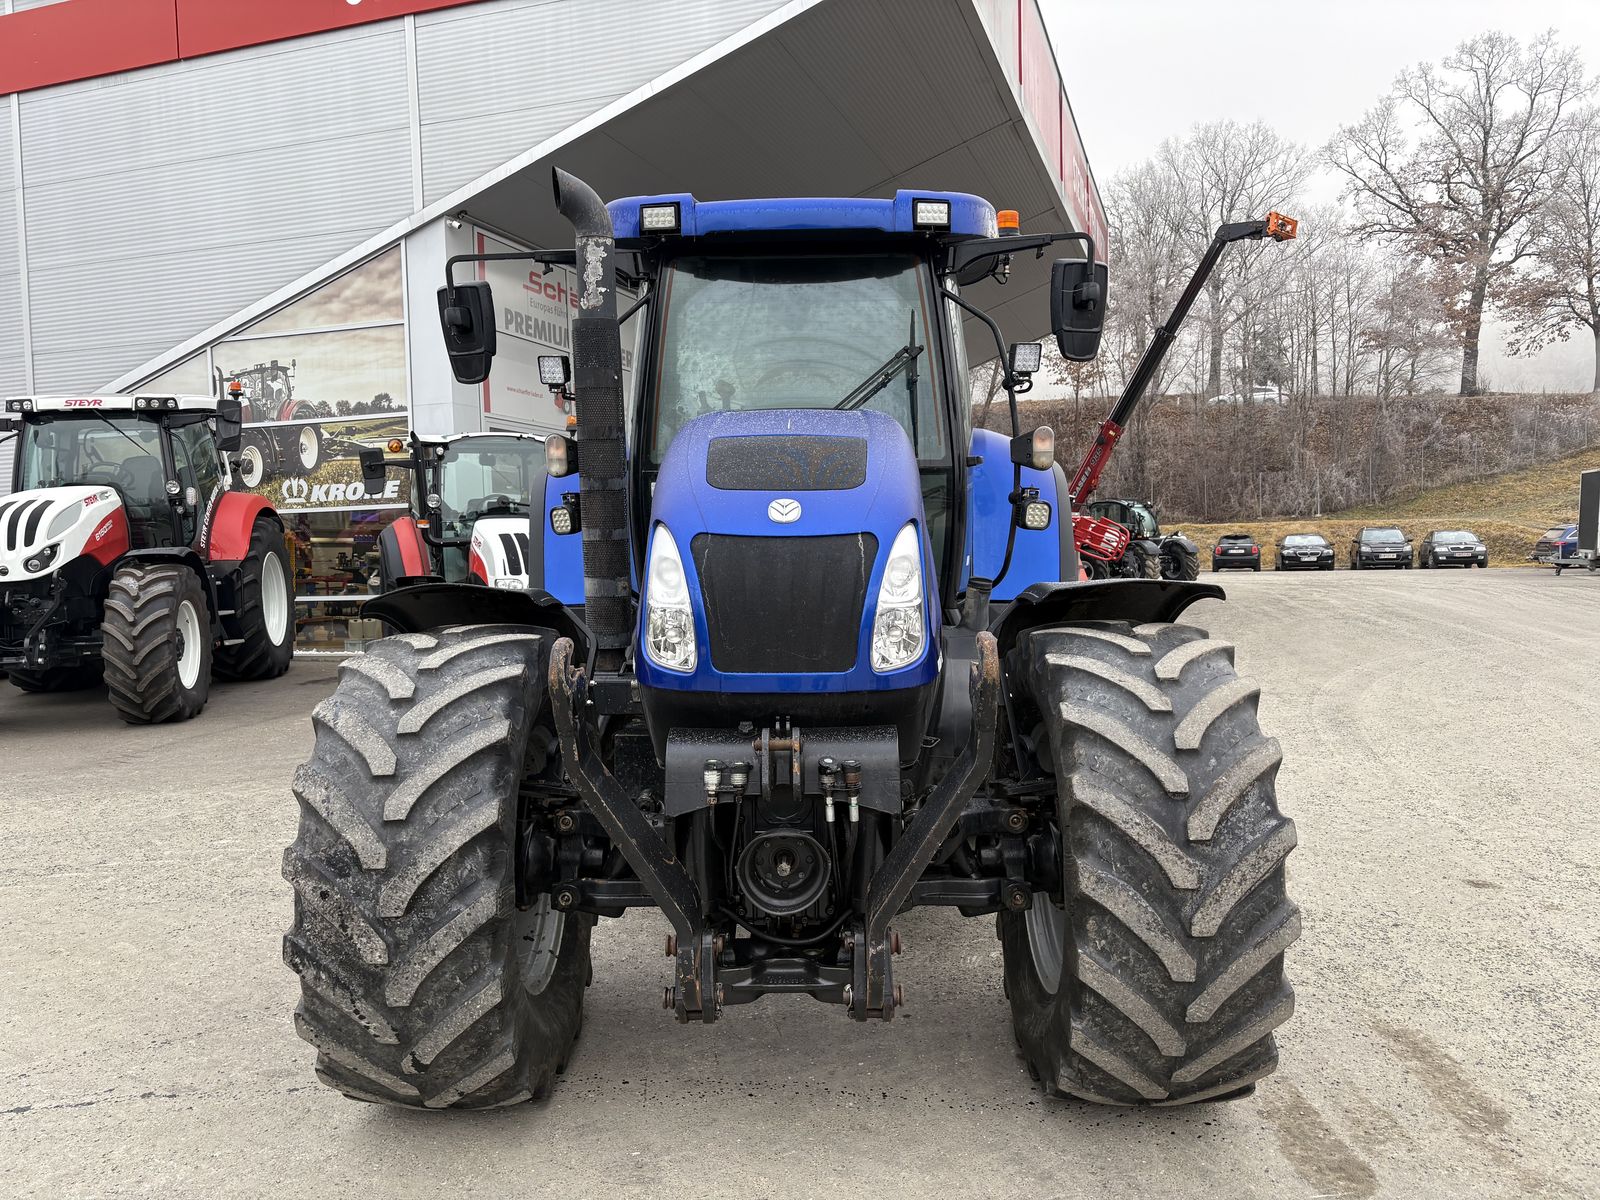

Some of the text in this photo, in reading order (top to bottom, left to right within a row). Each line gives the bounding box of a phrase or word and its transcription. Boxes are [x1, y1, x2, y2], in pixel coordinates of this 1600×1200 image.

[64, 399, 103, 407] STEYR
[310, 480, 401, 502] KROE
[83, 494, 98, 507] STEYR
[200, 524, 208, 549] STEYR
